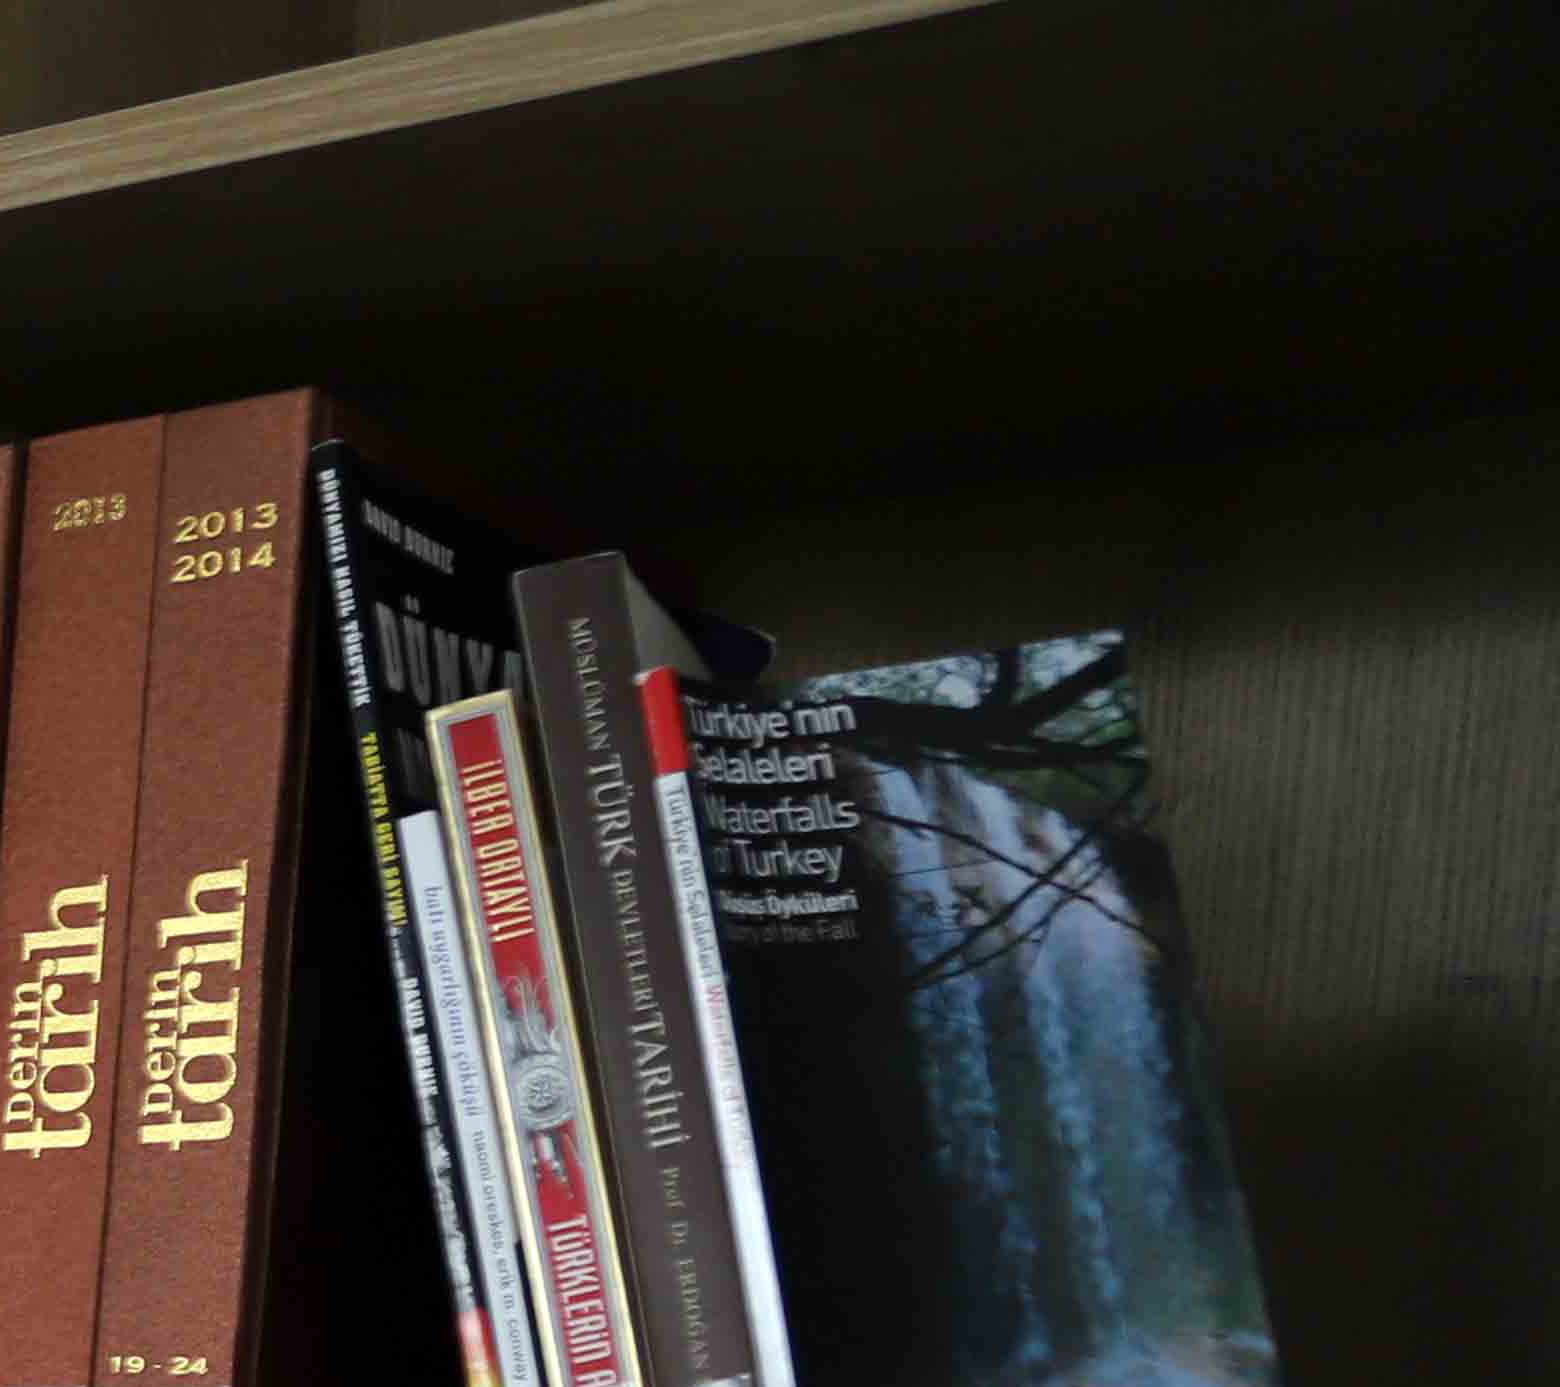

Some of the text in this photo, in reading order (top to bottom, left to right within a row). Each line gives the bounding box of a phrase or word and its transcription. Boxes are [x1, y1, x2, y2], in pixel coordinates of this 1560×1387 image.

[52, 493, 128, 532] 2013
[173, 503, 279, 544] 2013
[171, 542, 276, 584] 2014
[477, 837, 534, 943] ORTAYLI
[730, 844, 842, 880] Turkey
[590, 752, 637, 865] TÜRK
[630, 1025, 675, 1149] TARİHİ
[3, 874, 107, 1159] tarih
[140, 860, 247, 1151] tarih
